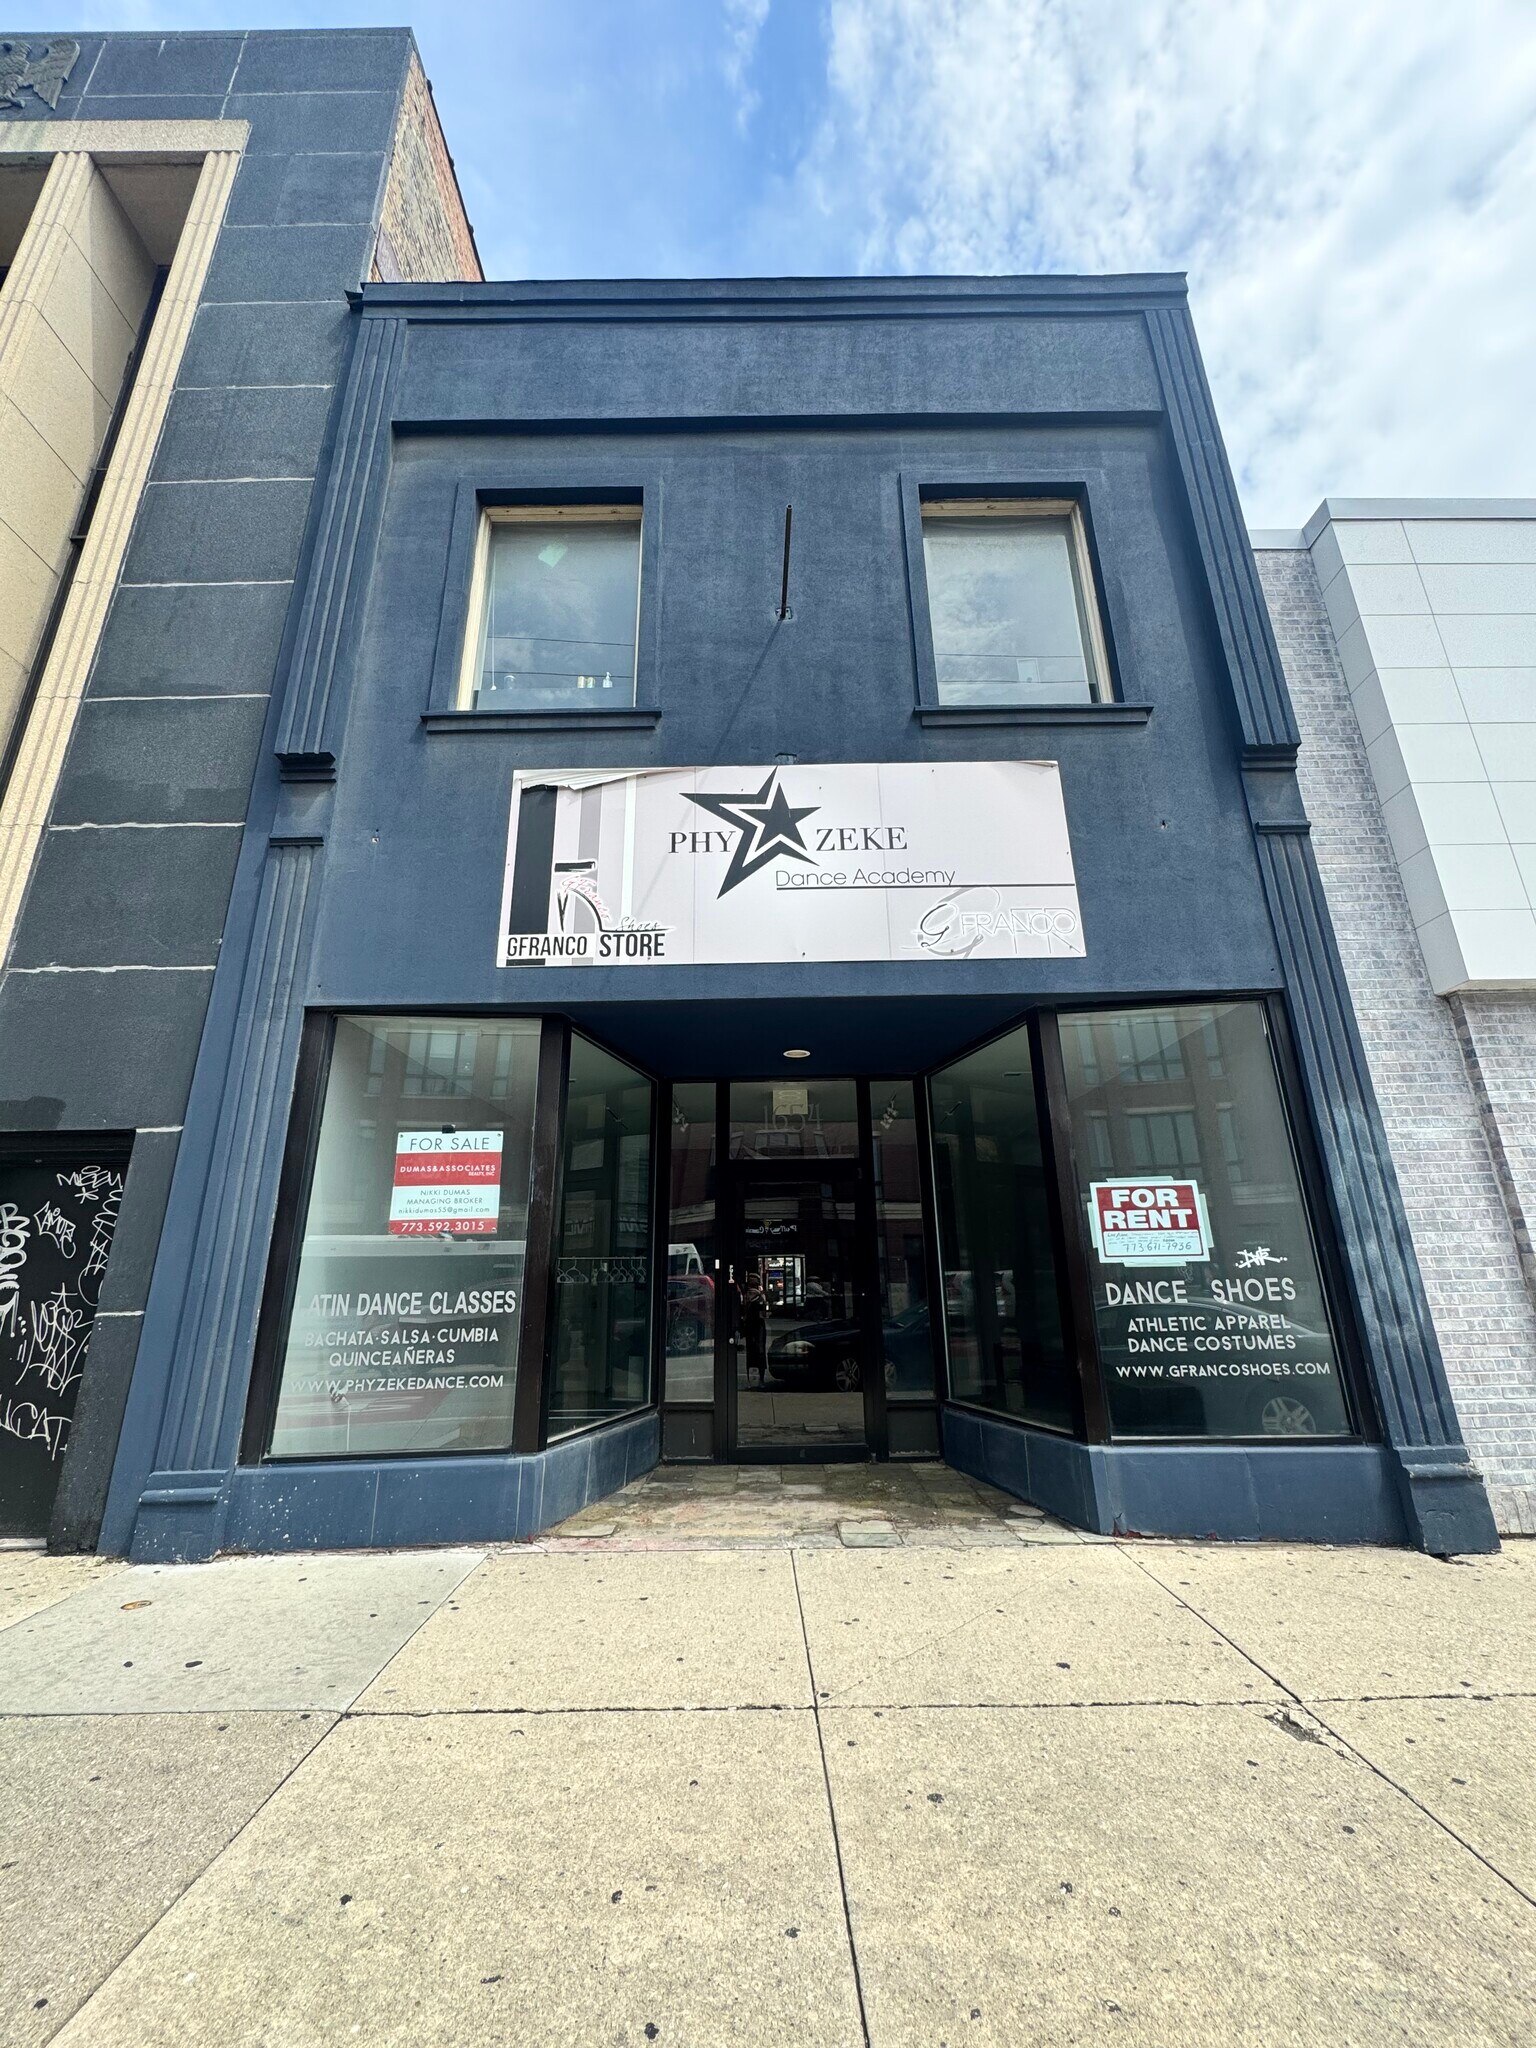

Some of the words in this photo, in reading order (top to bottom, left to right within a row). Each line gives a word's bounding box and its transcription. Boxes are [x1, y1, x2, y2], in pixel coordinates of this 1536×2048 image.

[668, 831, 736, 853] PHY
[815, 827, 908, 851] ZEKE
[776, 870, 847, 887] Dance
[853, 868, 955, 887] Academy
[507, 936, 588, 957] GFRANCO
[599, 933, 666, 957] STORE
[410, 1138, 443, 1151] FOR
[450, 1137, 490, 1150] SALE
[400, 1164, 496, 1173] DUMAS&ASSOCIATES
[1111, 1188, 1180, 1208] FOR
[401, 1221, 485, 1232] 773.592.3015
[1103, 1208, 1193, 1229] RENT
[1105, 1280, 1188, 1306] DANCE
[1210, 1277, 1297, 1302] SHOES
[356, 1291, 423, 1316] DANCE
[429, 1290, 517, 1315] CLASSES
[1127, 1316, 1207, 1333] ATHLETIC
[1214, 1314, 1292, 1331] APPAREL
[1127, 1336, 1188, 1353] DANCE
[1194, 1334, 1296, 1351] COSTUMES
[329, 1346, 456, 1367] QUINCEAÑERAS
[1115, 1362, 1331, 1378] WWW.GFRANCOSHOES.COM
